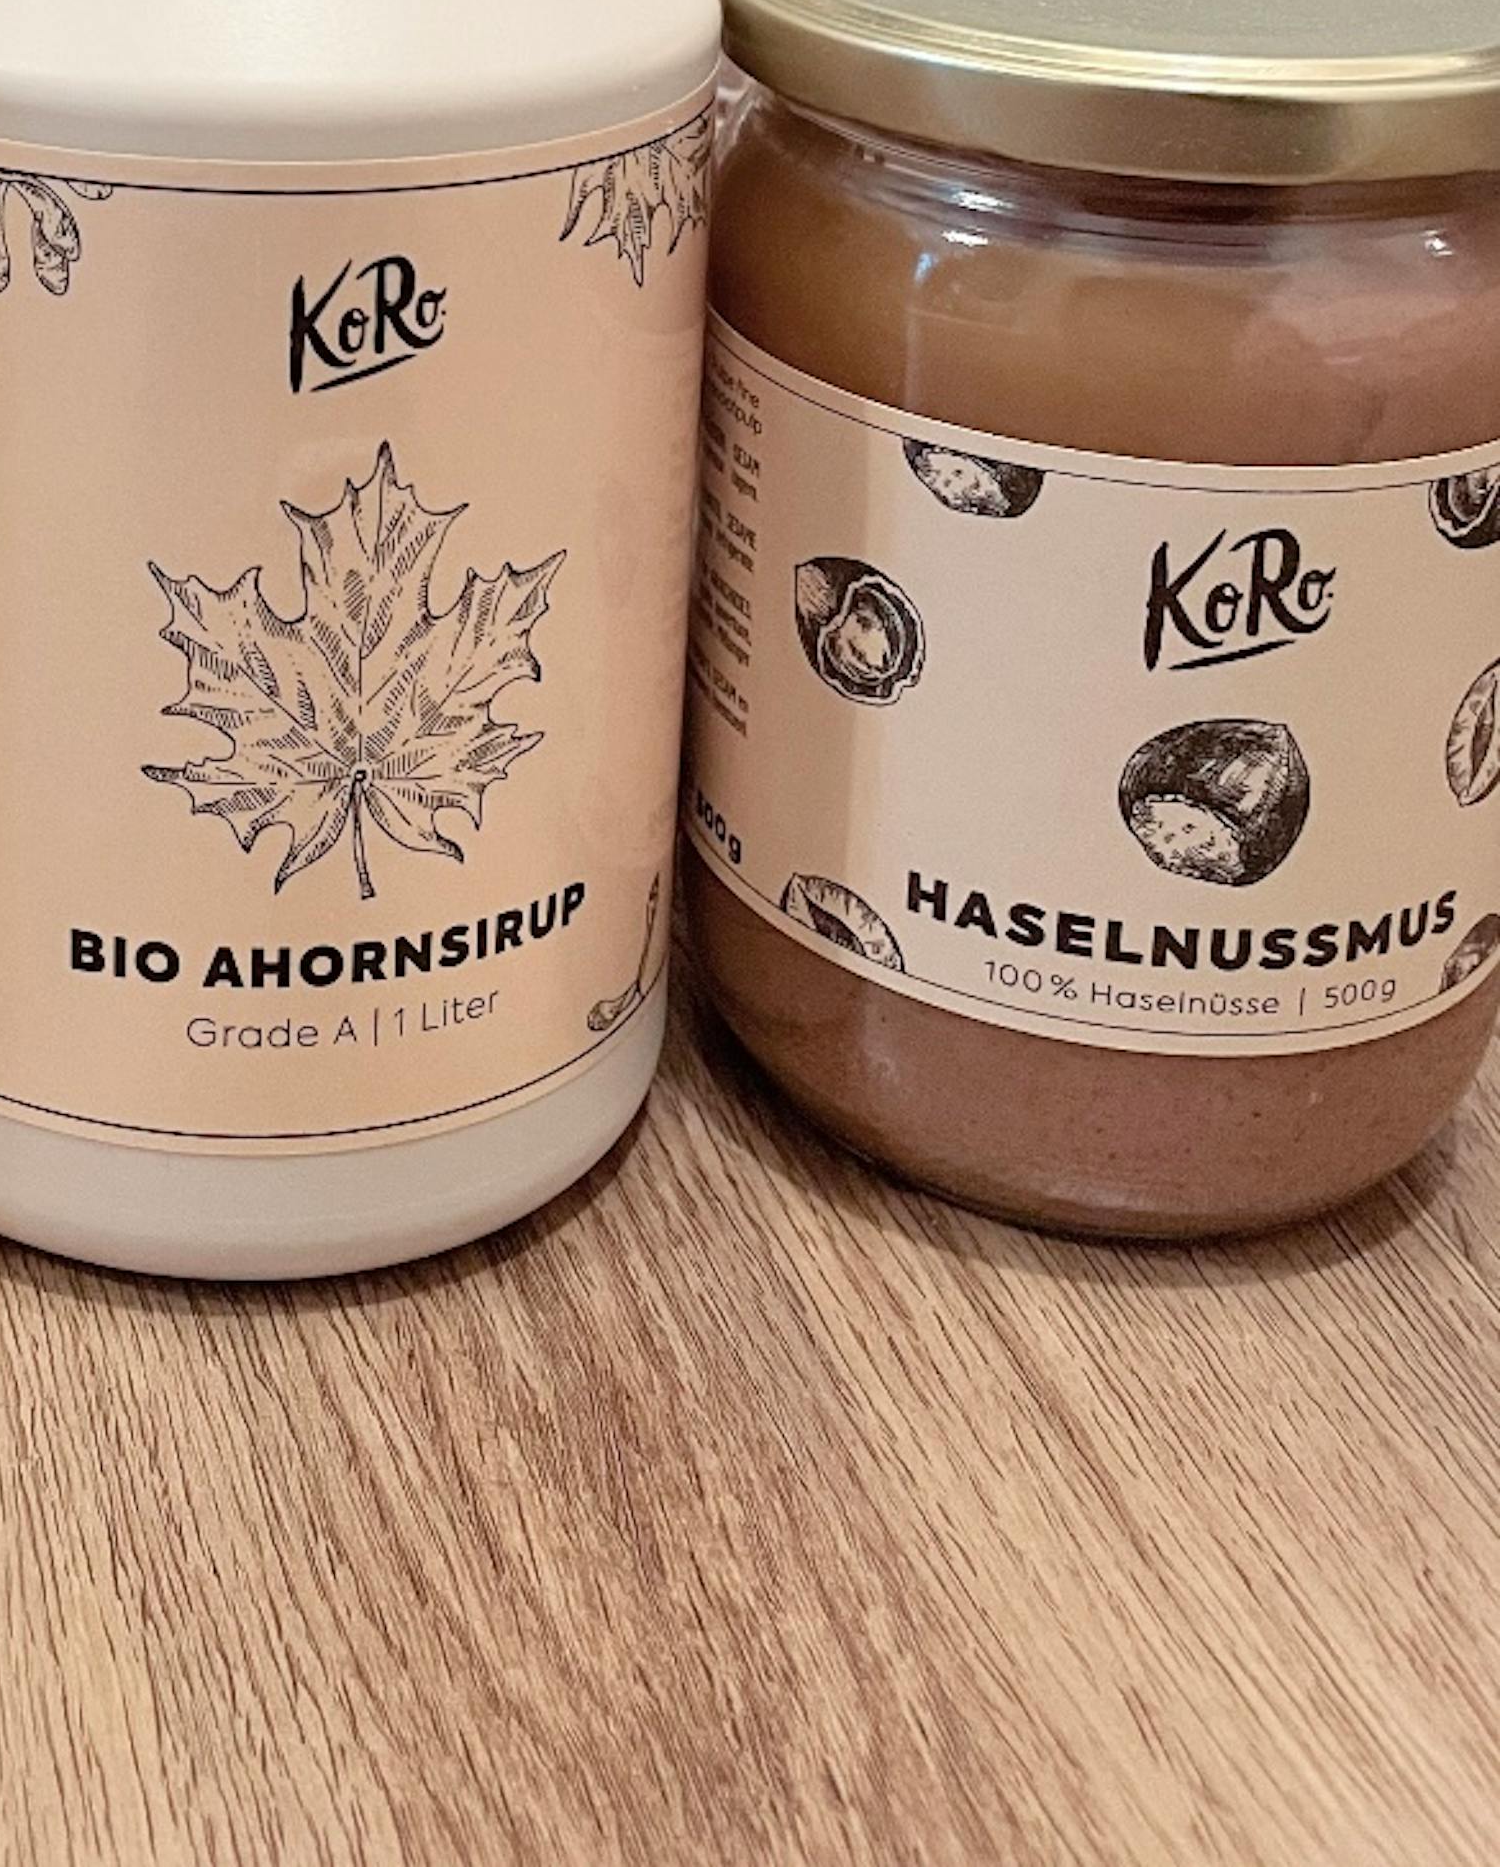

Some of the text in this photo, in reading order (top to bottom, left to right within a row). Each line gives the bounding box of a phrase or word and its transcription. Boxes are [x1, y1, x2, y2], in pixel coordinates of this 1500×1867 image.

[70, 881, 586, 989] BIO AHORNSIRUP
[906, 870, 1457, 971] HASELNUSSMUS
[186, 1015, 319, 1049] Grade
[333, 1015, 358, 1046] A
[392, 1007, 404, 1037] 1
[421, 988, 499, 1033] Liter
[1090, 983, 1280, 1016] Haselnüsse
[1324, 978, 1397, 1011] 500g
